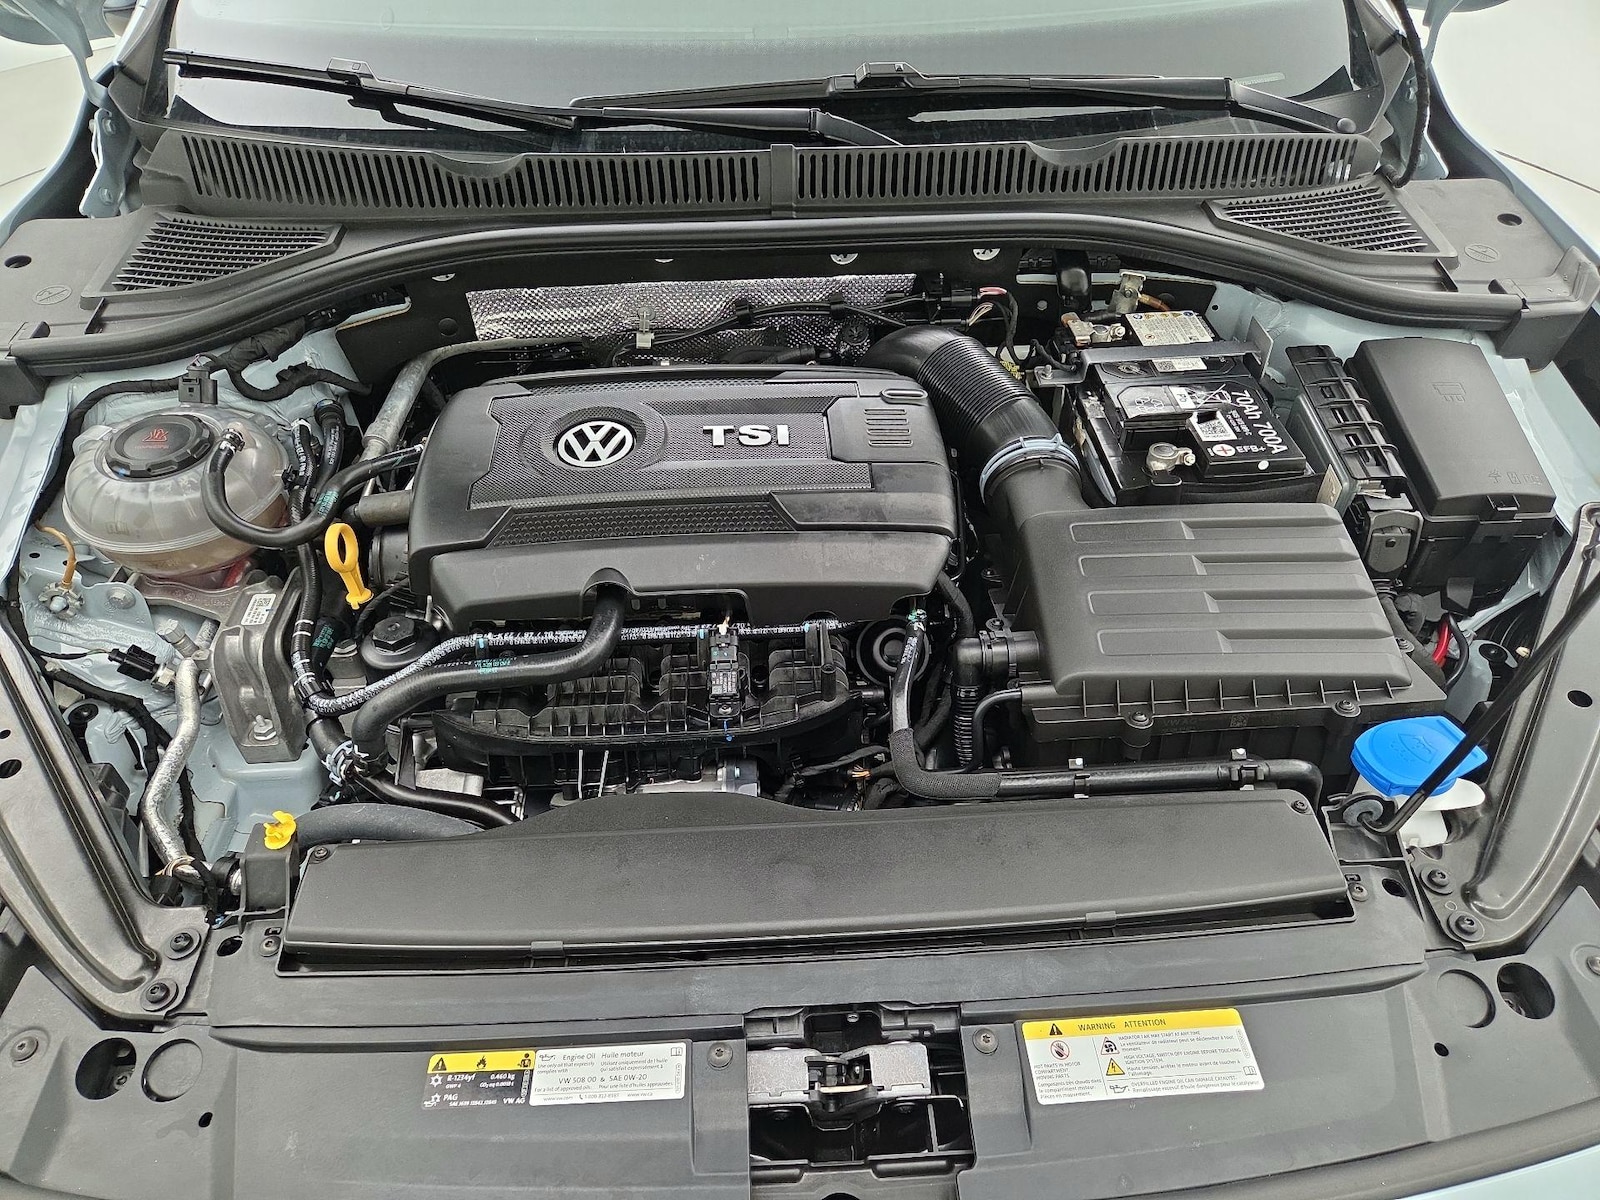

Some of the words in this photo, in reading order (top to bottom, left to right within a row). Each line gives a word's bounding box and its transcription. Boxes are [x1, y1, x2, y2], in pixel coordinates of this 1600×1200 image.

[1231, 390, 1262, 419] 70Ah
[1253, 421, 1288, 454] 700A
[702, 424, 790, 447] TSI
[1235, 445, 1266, 453] EFB+
[1078, 1022, 1116, 1031] WARNING
[1124, 1018, 1166, 1028] ATTENTION
[563, 1054, 585, 1062] Engine
[447, 1073, 477, 1082] R-1234yf
[624, 1073, 648, 1081] 0W-20
